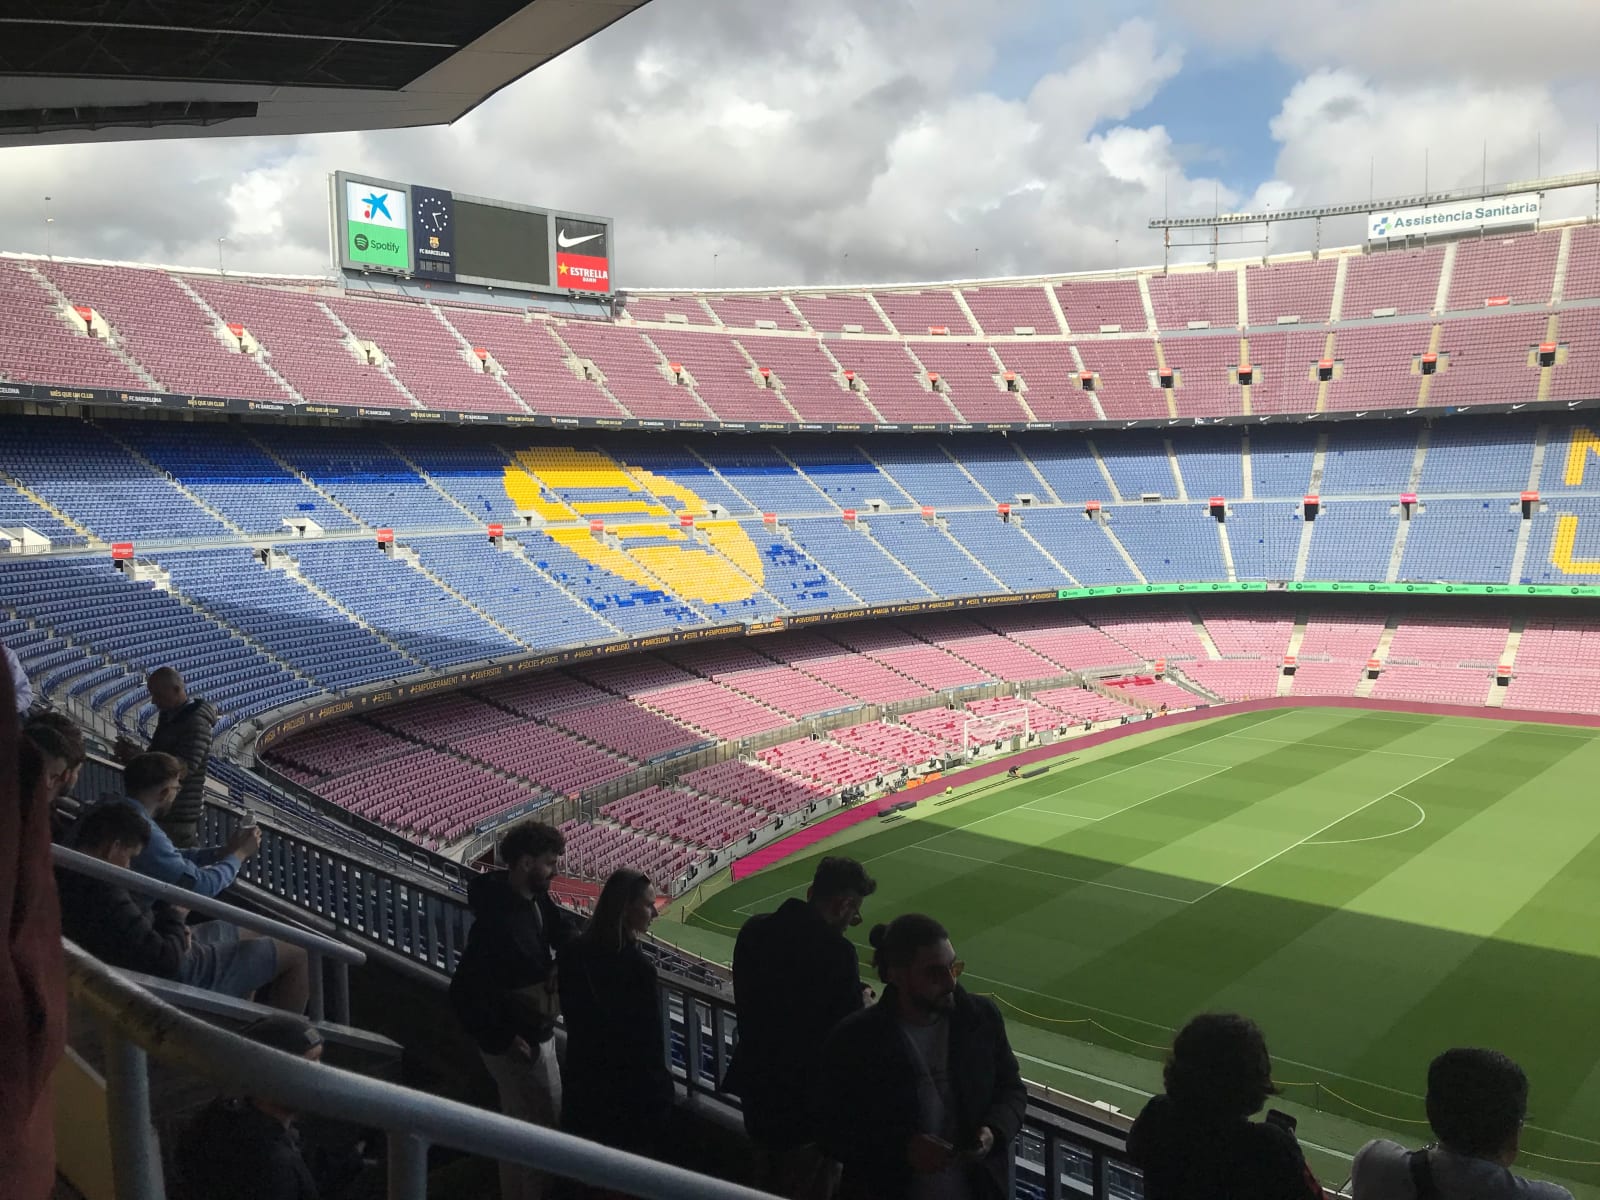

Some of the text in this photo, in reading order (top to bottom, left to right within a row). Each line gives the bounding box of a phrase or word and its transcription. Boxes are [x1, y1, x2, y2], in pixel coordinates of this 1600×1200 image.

[1394, 203, 1537, 228] Assistència Sanitària
[370, 240, 400, 254] Spotify
[570, 266, 608, 279] ESTRELLA
